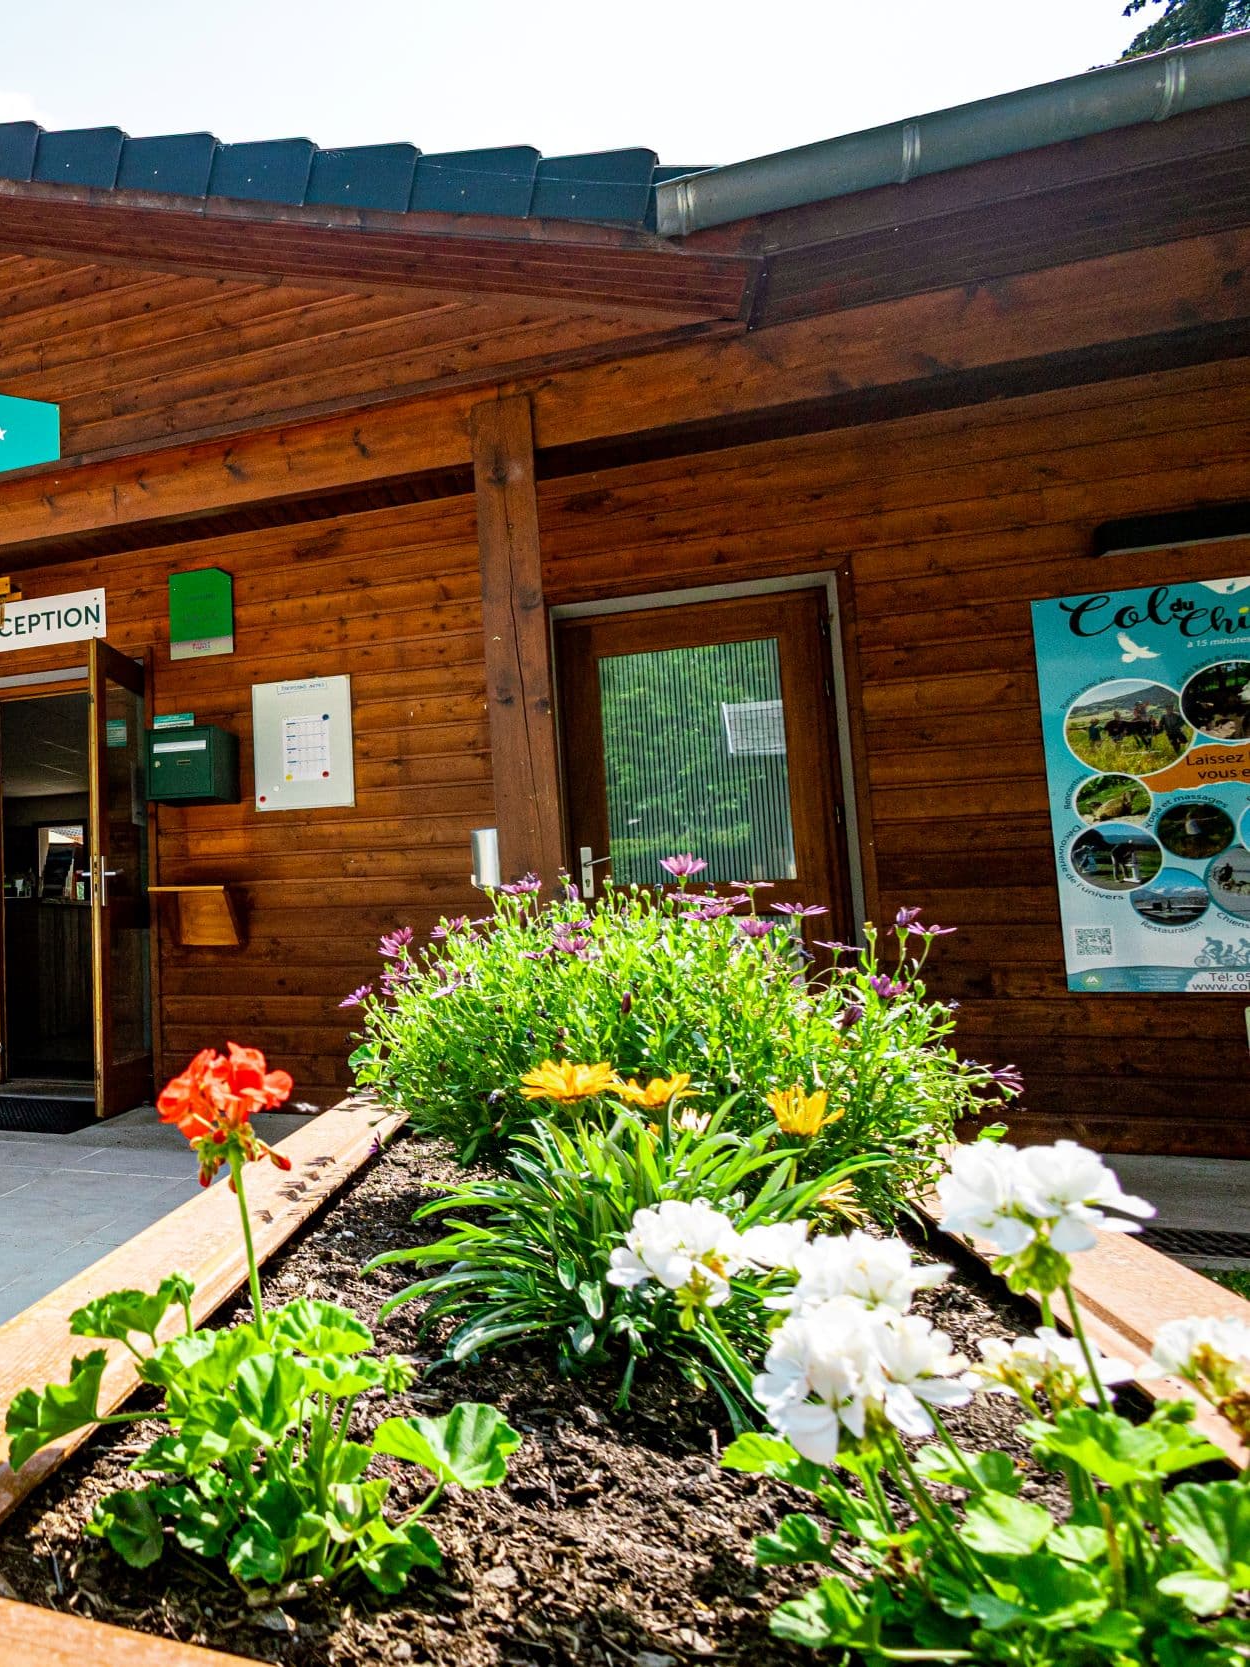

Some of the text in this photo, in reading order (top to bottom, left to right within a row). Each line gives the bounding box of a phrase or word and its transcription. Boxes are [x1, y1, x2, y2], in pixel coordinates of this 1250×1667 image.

[1059, 587, 1173, 637] Col
[1170, 597, 1195, 613] du
[1185, 754, 1246, 766] Laissez
[1197, 769, 1237, 780] vous
[1173, 794, 1229, 809] massages
[1140, 920, 1204, 934] Restauration
